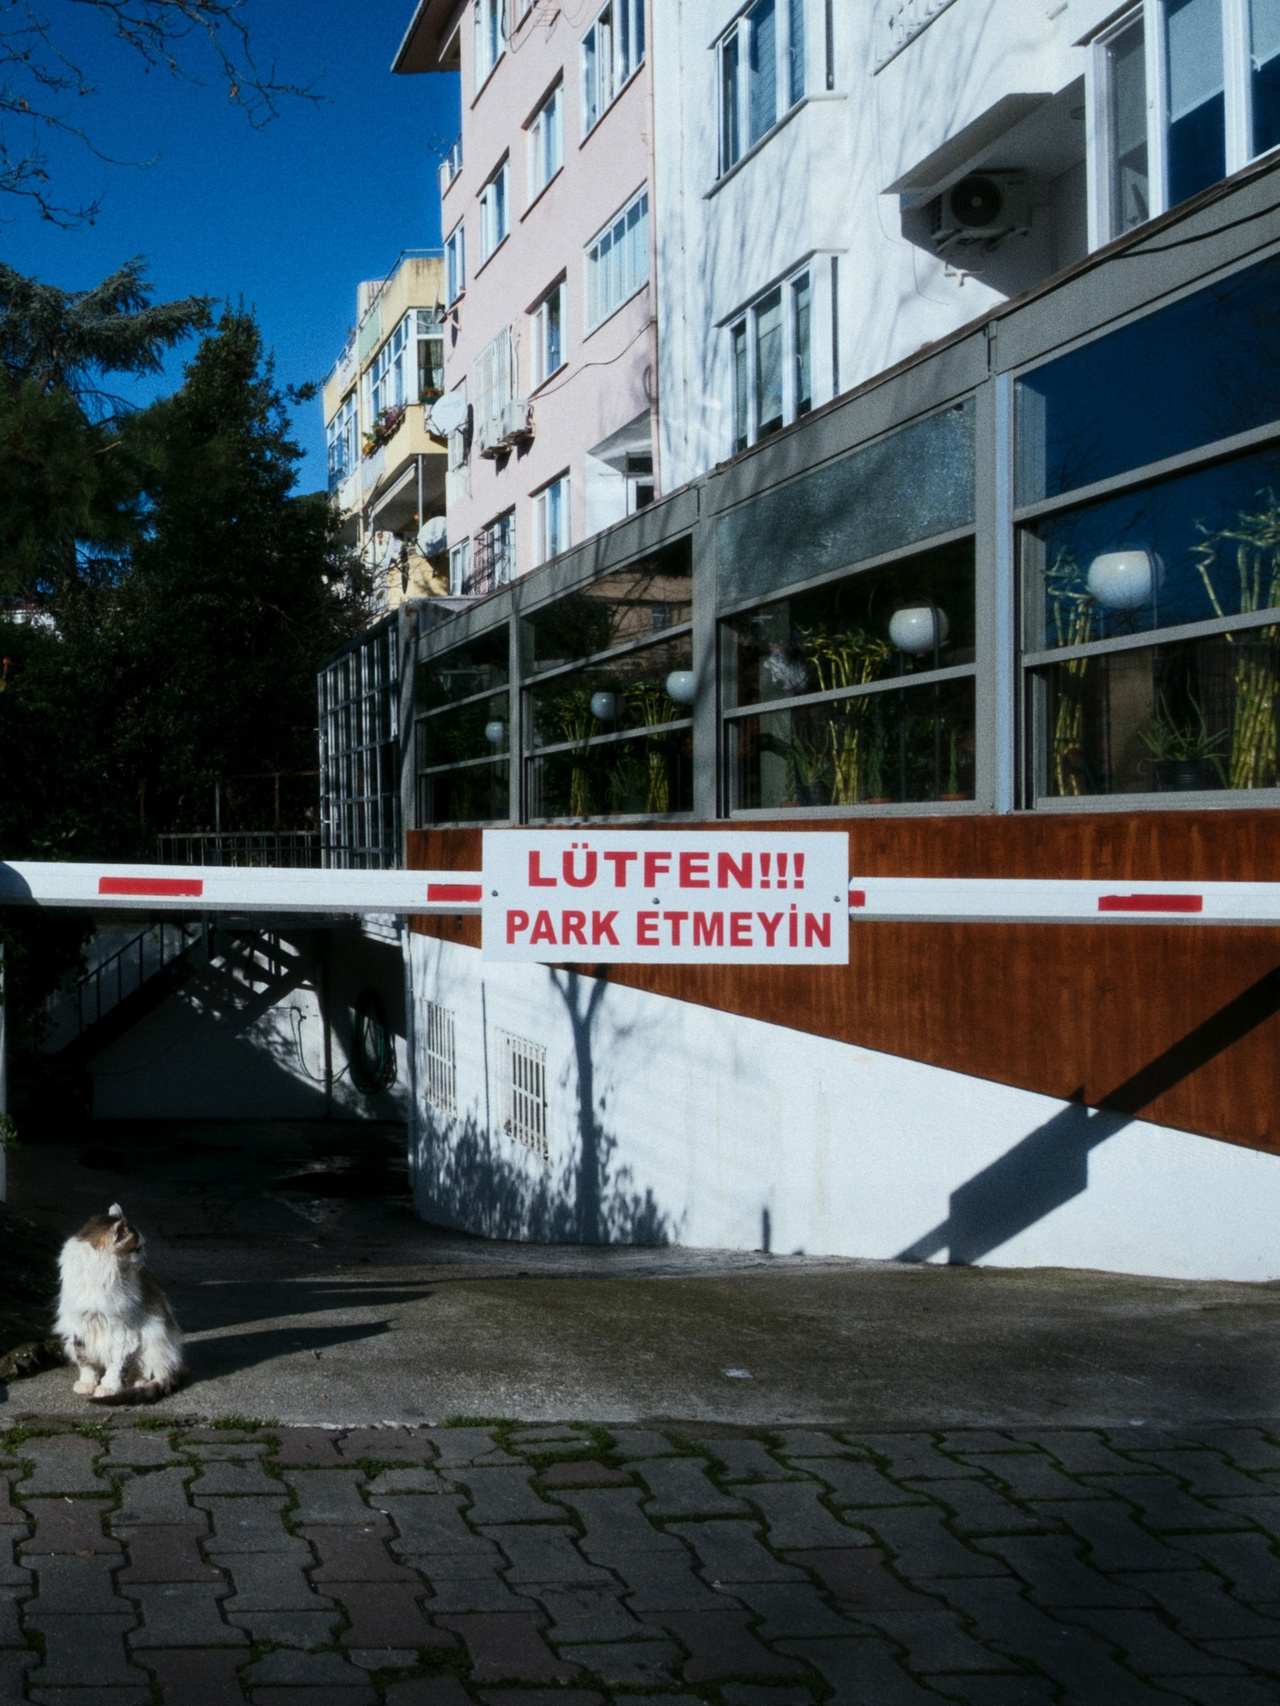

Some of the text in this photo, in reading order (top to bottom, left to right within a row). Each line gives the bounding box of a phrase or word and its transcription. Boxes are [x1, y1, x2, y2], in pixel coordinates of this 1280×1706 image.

[528, 842, 805, 889] LÜTFEN!!!
[506, 903, 831, 948] PARK ETMEYİN
